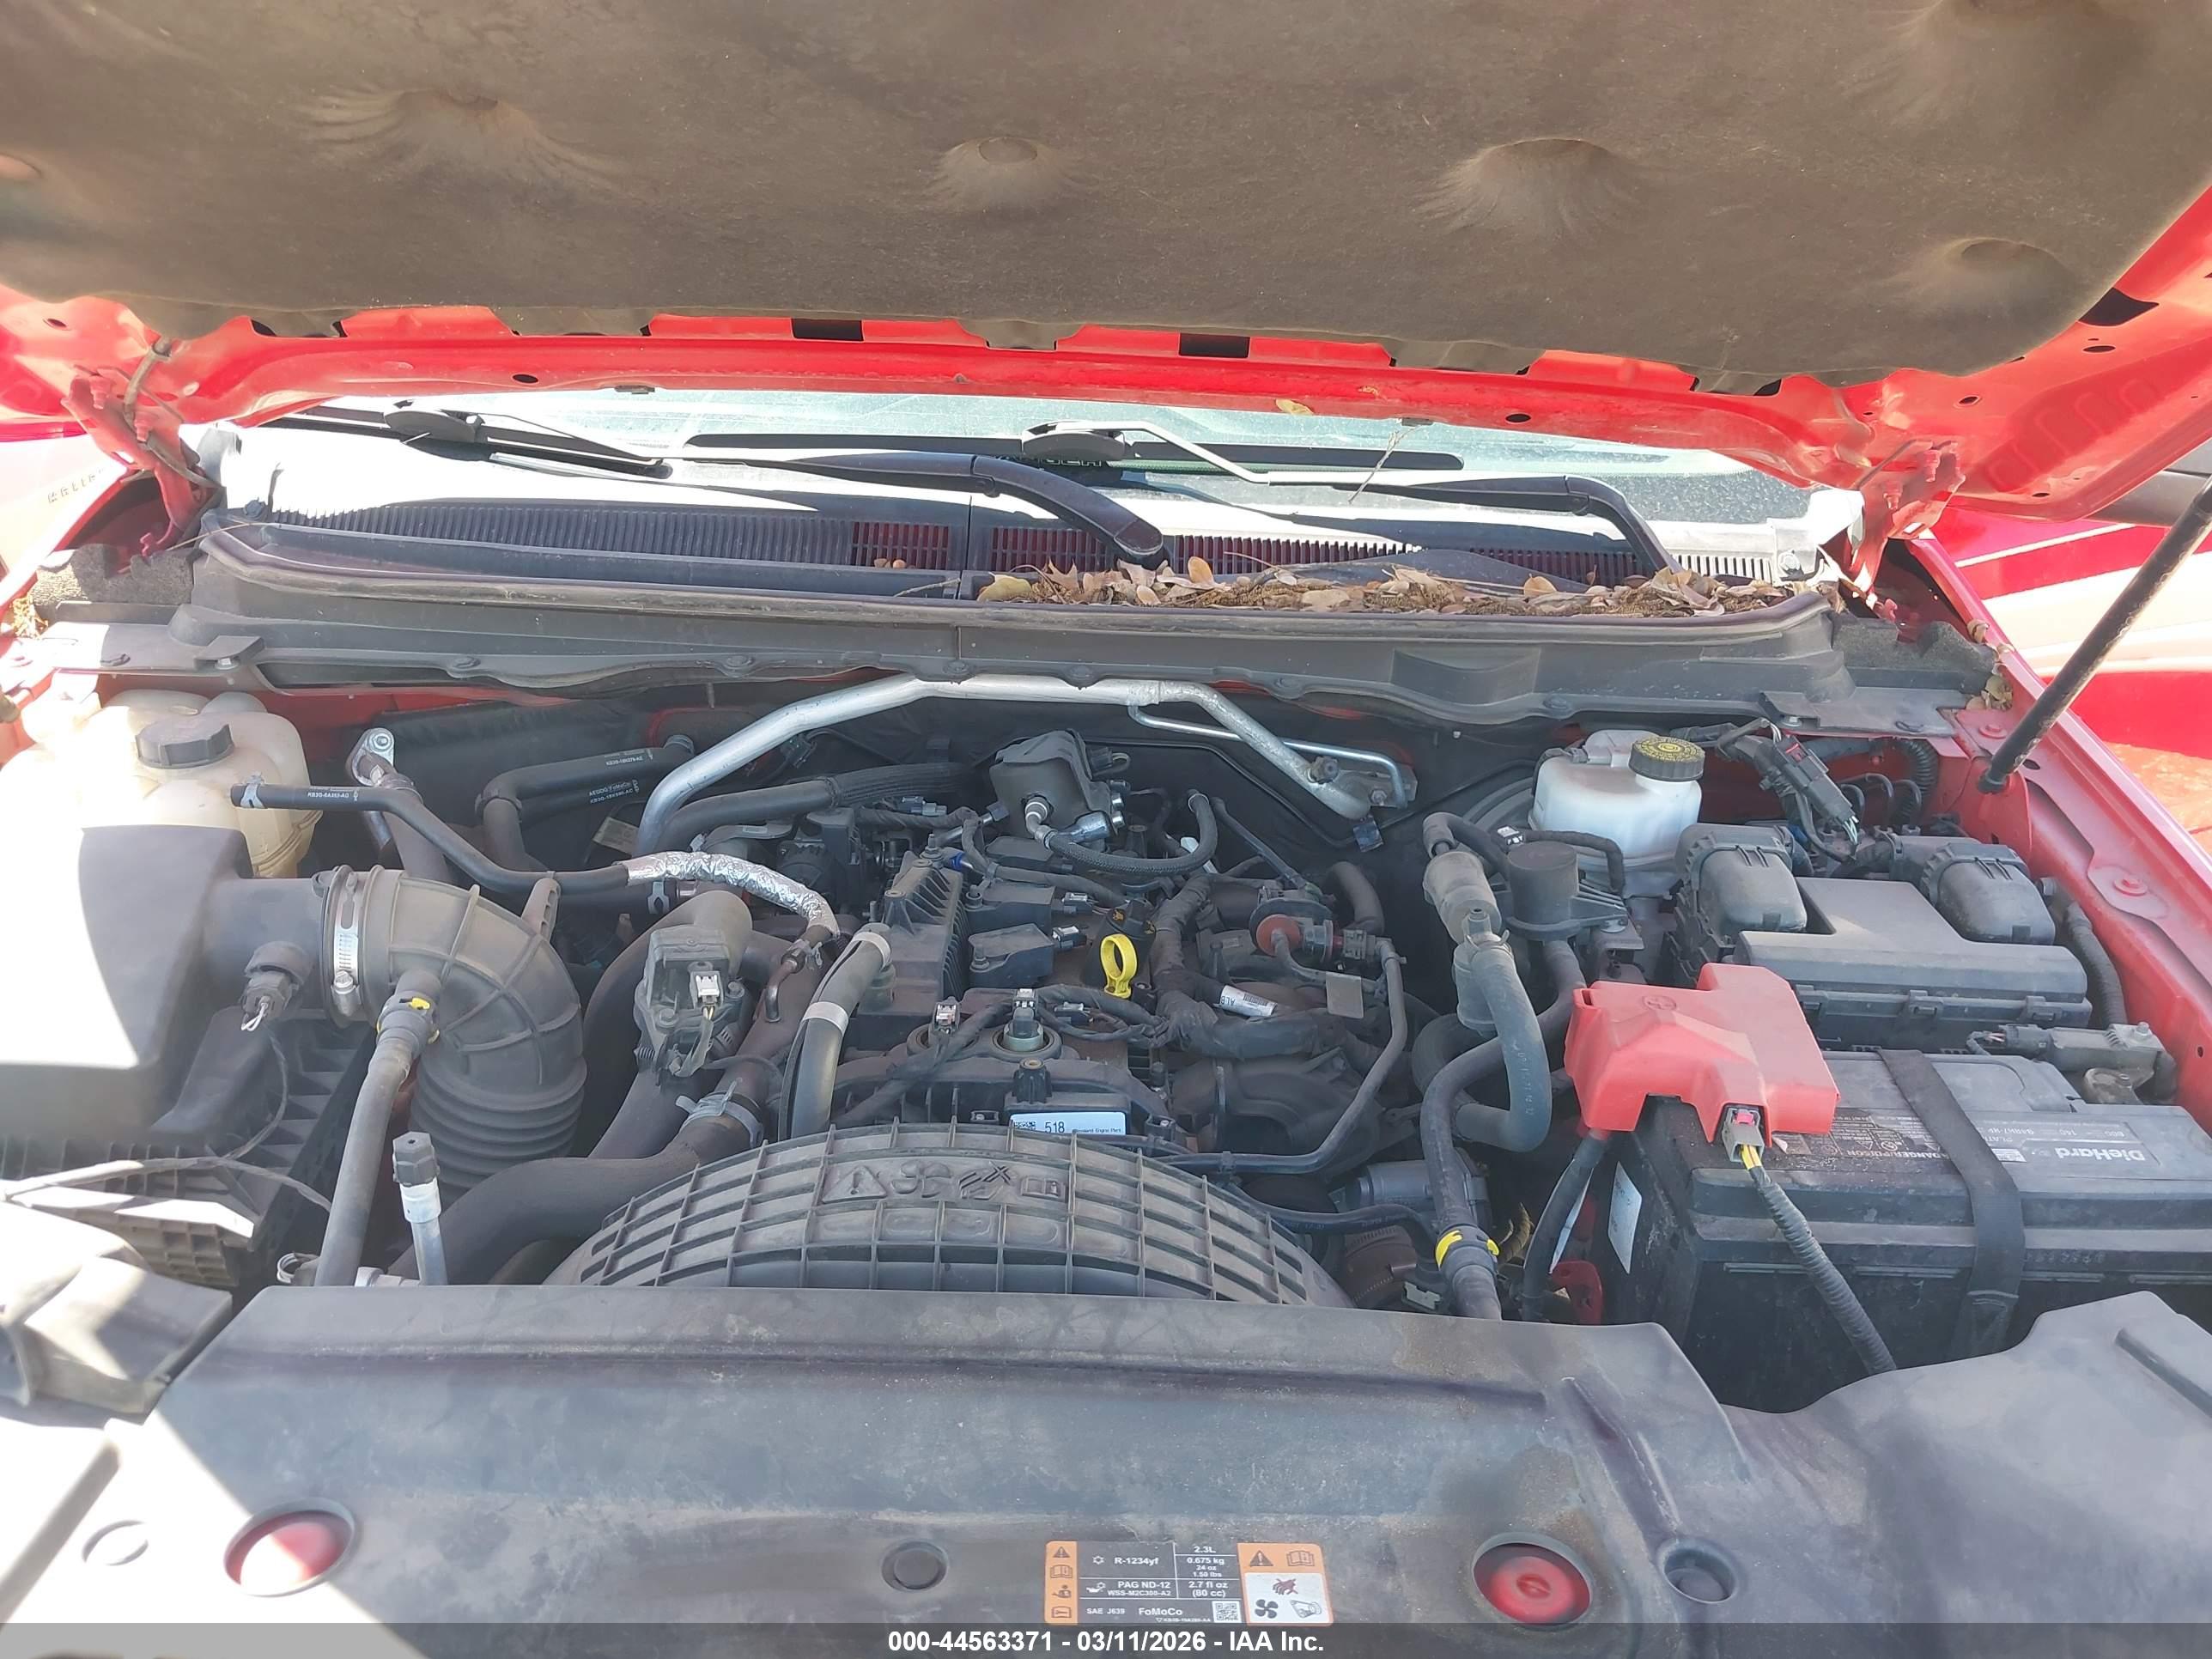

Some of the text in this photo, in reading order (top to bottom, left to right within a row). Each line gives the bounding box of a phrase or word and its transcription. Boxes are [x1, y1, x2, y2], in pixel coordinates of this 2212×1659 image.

[1044, 1121, 1066, 1133] 518
[2055, 1147, 2146, 1161] DieHard
[1115, 1557, 1159, 1566] R-1234yf
[1192, 1589, 1226, 1598] (80 cc)
